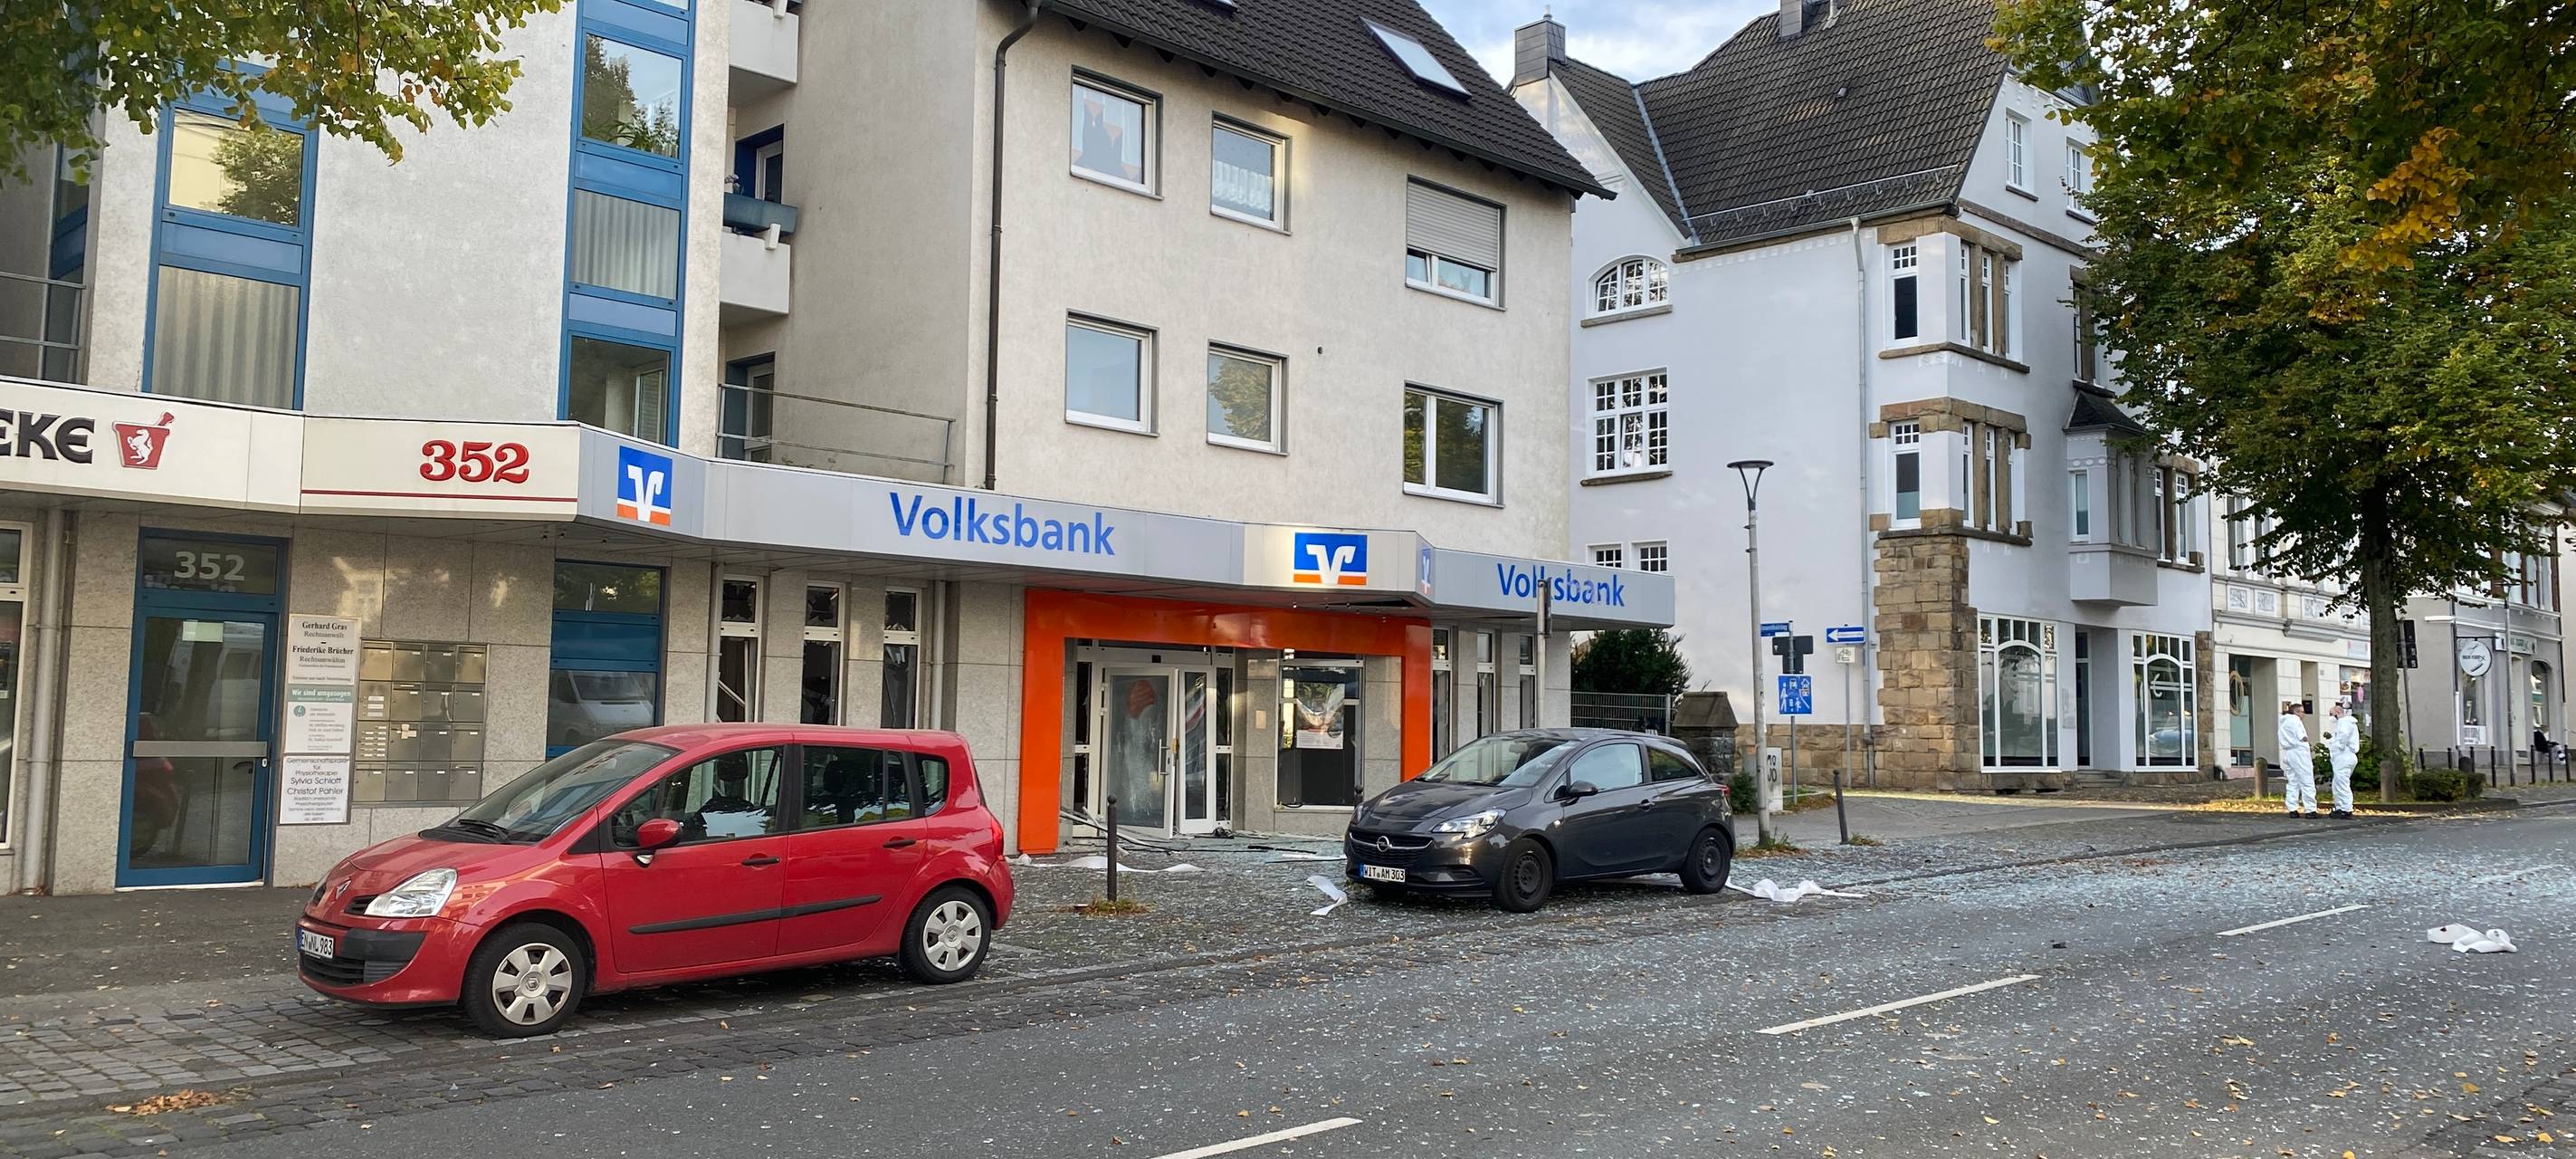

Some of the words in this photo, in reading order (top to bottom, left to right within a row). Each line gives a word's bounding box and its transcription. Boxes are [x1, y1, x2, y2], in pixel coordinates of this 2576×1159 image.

[419, 439, 530, 484] 352
[889, 492, 1116, 556] Volksbank
[174, 551, 245, 581] 352
[301, 621, 330, 629] Gerhard
[331, 622, 348, 631] Gras
[292, 645, 327, 654] Friederike
[328, 647, 354, 655] Brücher
[317, 690, 351, 698] umgezogen
[290, 777, 313, 786] Sylvia
[286, 787, 318, 795] Christof
[1391, 869, 1405, 881] 303
[320, 937, 333, 955] 983
